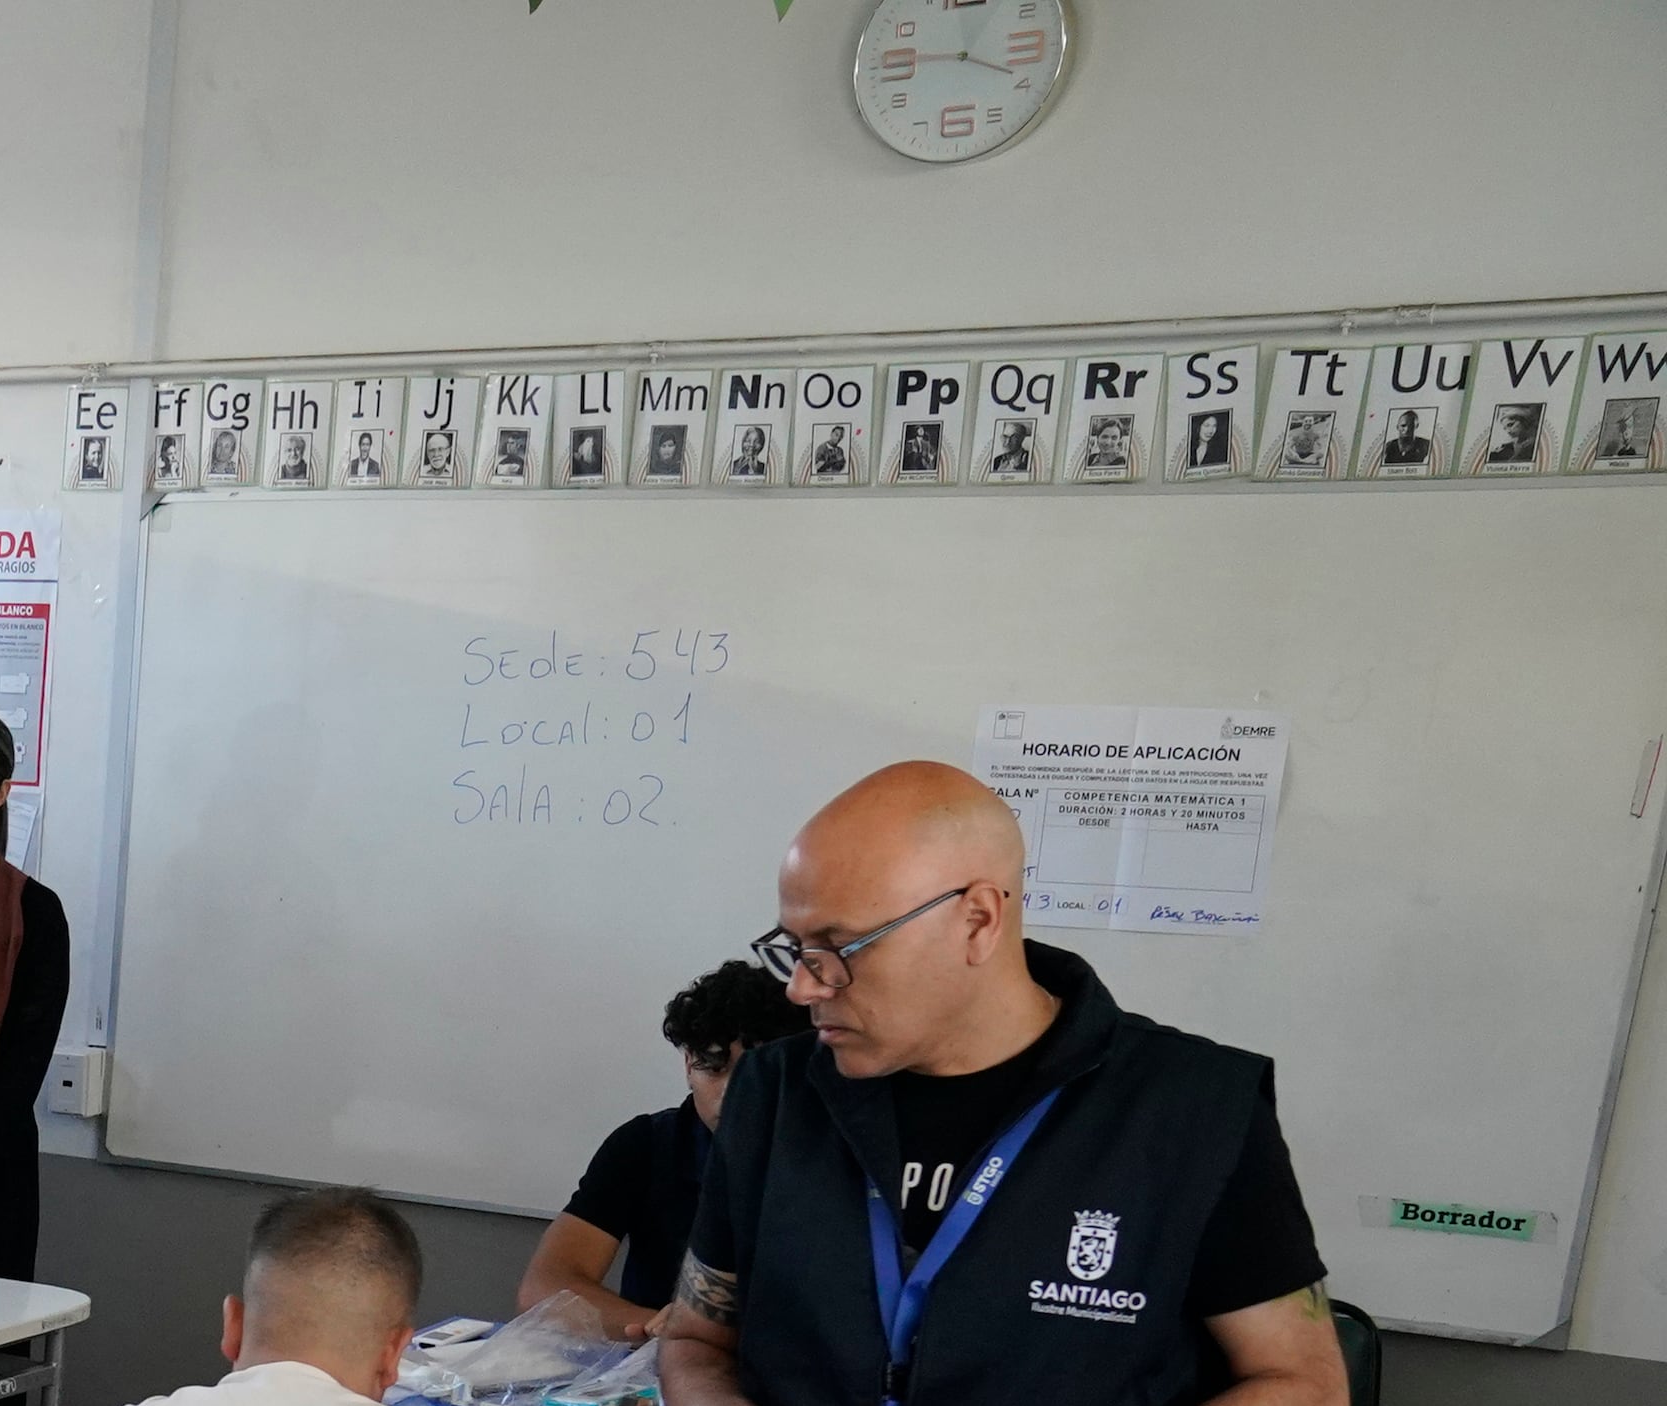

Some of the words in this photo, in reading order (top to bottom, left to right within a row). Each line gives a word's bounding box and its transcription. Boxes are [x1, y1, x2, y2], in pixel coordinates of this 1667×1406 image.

[1019, 2, 1037, 19] 2
[896, 21, 916, 39] 10
[1007, 29, 1045, 66] 3
[881, 47, 917, 83] 9
[891, 92, 908, 109] 8
[1014, 77, 1032, 92] 4
[913, 120, 929, 136] 7
[940, 103, 977, 138] 6
[986, 106, 1003, 124] 5
[1084, 362, 1148, 400] Rr
[1186, 352, 1239, 399] Ss
[1290, 350, 1347, 396] Tt
[1391, 345, 1471, 393] Uu
[1503, 339, 1574, 388] Vv
[206, 383, 251, 431] Gg
[352, 378, 382, 418] Ii
[424, 378, 454, 430] Jj
[496, 375, 541, 416] Kk
[580, 371, 611, 414] Ll
[640, 377, 708, 411] Mm
[728, 374, 786, 409] Nn
[804, 373, 862, 408] Oo
[896, 370, 960, 415] Pp
[990, 364, 1055, 415] Qq
[76, 392, 117, 430] Ee
[154, 388, 190, 428] Ff
[272, 389, 319, 430] Hh
[625, 630, 732, 680] 543
[631, 692, 691, 744] 01
[1233, 726, 1276, 737] DEMRE
[1022, 743, 1101, 758] HORARIO
[1106, 745, 1130, 759] DE
[1133, 745, 1241, 761] APLICACIÓN
[989, 787, 1021, 798] ALA
[1064, 791, 1149, 803] COMPETENCIA
[1154, 793, 1235, 806] MATEMÁTICA
[1240, 798, 1246, 806] 1
[1059, 805, 1117, 816] DURACIÓN:
[1121, 808, 1127, 816] 2
[1129, 808, 1166, 817] HORAS
[1171, 809, 1178, 817] Y
[1180, 810, 1193, 818] 20
[1196, 810, 1246, 820] MINUTOS
[1079, 818, 1110, 827] DESDE
[1186, 822, 1219, 831] HASTA
[1400, 1202, 1527, 1232] Borrador
[1028, 1280, 1147, 1311] SANTIAGO
